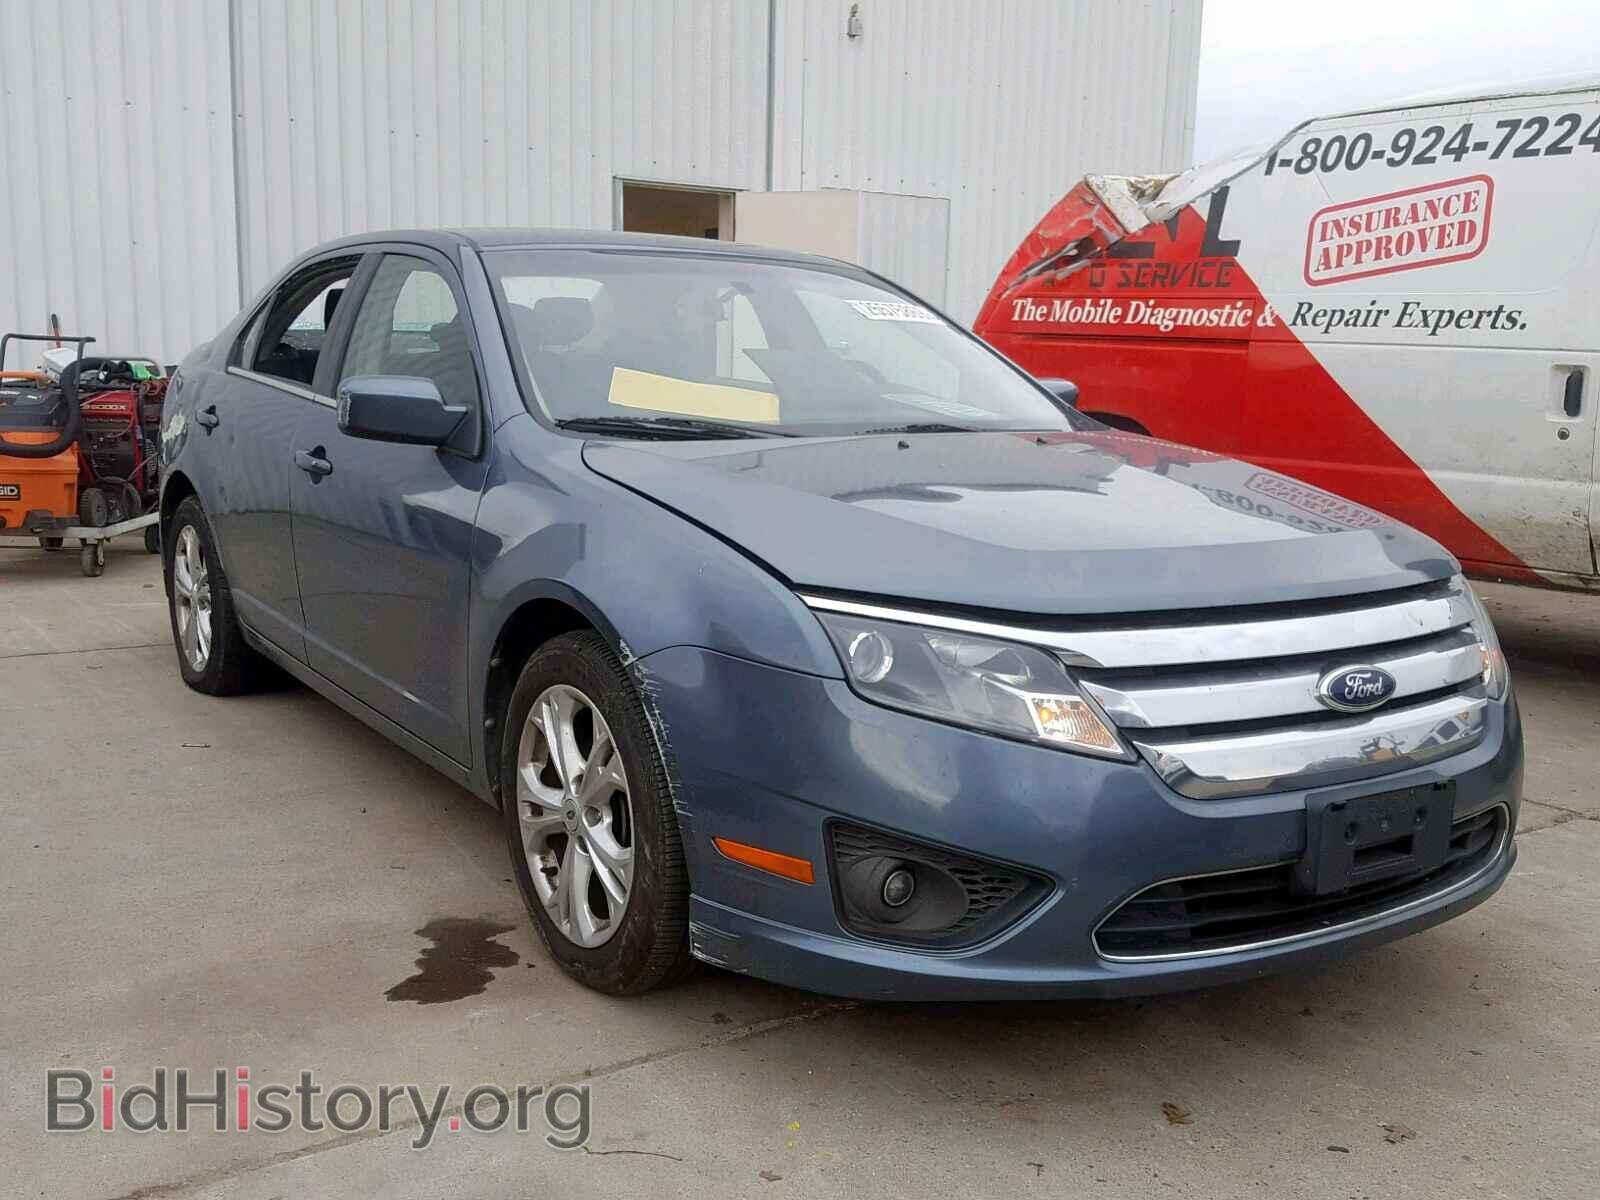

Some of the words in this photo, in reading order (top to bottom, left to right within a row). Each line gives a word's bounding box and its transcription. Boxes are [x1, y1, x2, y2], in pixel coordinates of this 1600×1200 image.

[1264, 112, 1600, 176] 1-800-924-7224
[1318, 190, 1480, 242] INSURANCE
[1314, 218, 1478, 272] APPROVED
[1116, 261, 1237, 288] SERVICE
[1011, 297, 1047, 322] The
[1049, 298, 1122, 325] Mobile
[1124, 299, 1253, 333] Diagnostic
[1256, 302, 1276, 328] &
[1288, 299, 1390, 335] Repair
[1392, 300, 1528, 337] Experts.
[1344, 672, 1384, 699] Ford
